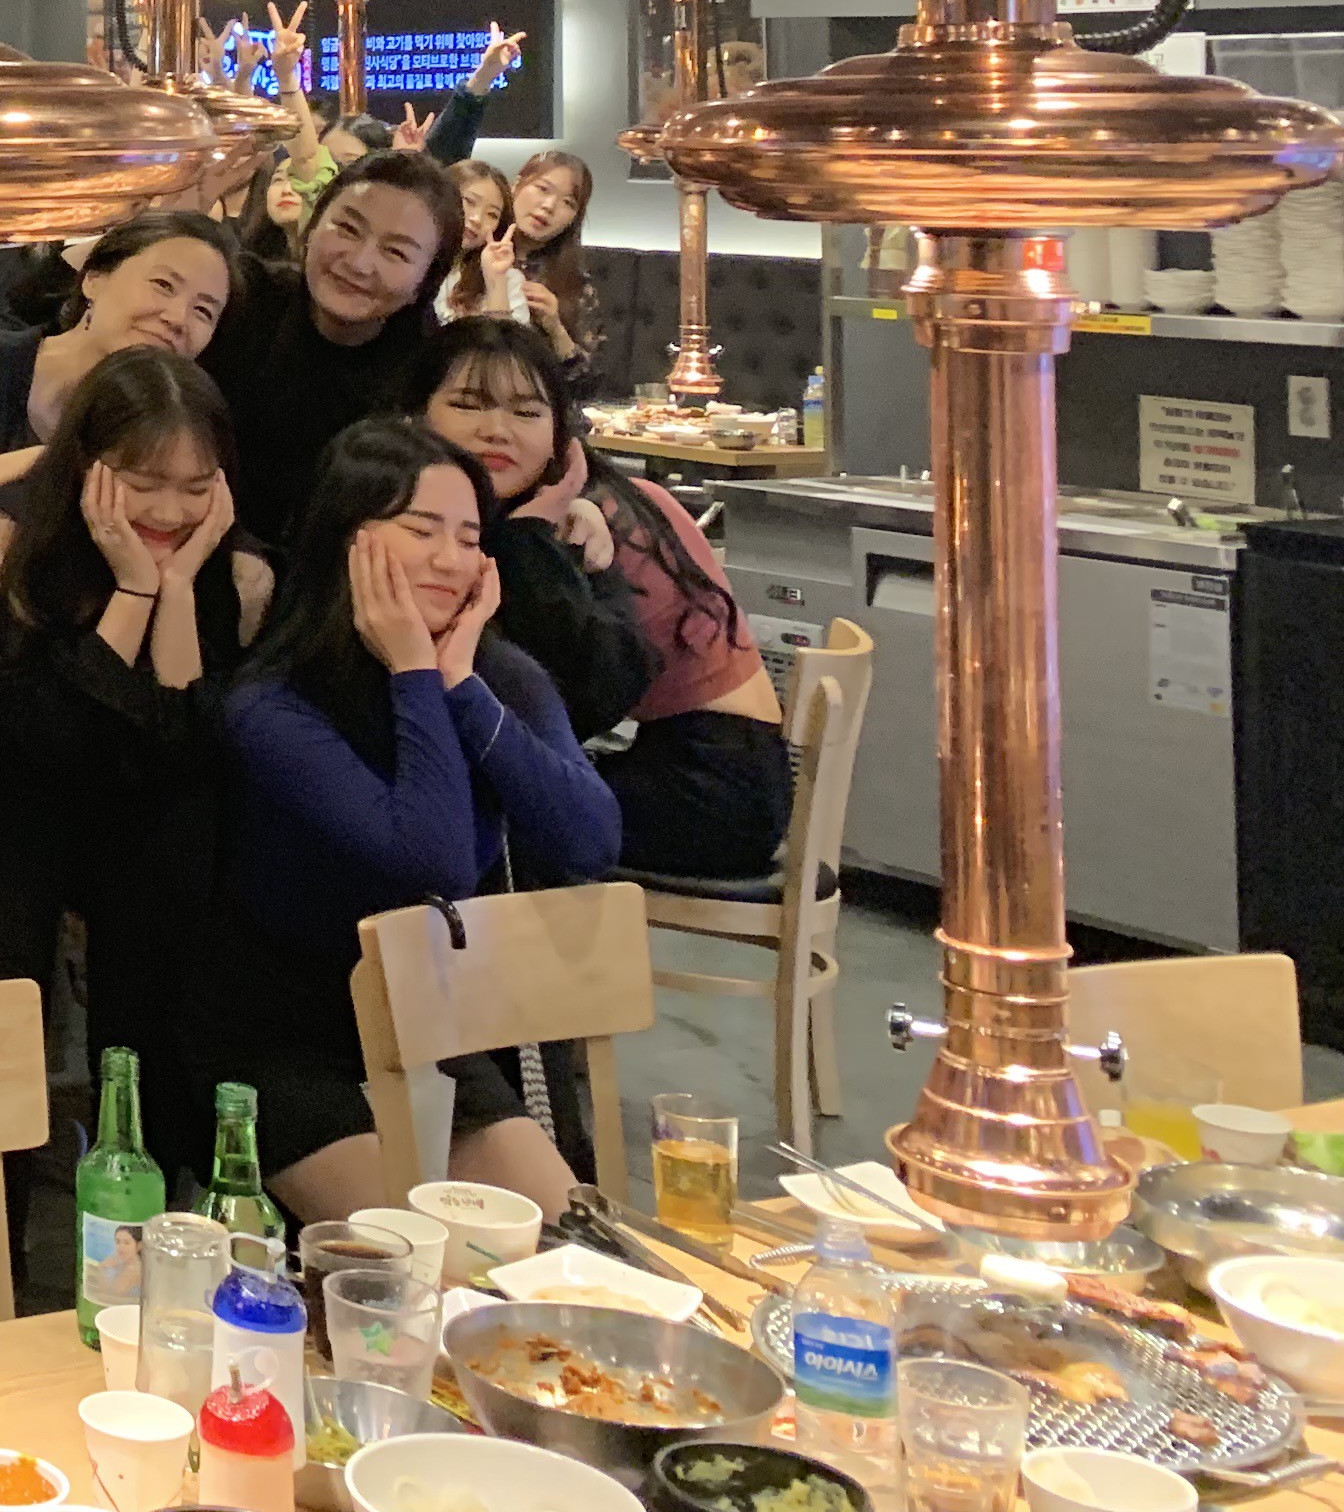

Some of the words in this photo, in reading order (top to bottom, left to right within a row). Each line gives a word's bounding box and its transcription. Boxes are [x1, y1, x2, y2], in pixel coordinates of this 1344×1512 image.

[320, 37, 340, 54] 임금
[365, 34, 386, 52] 비와
[385, 33, 414, 52] 고기를
[414, 33, 434, 51] 먹기
[434, 32, 455, 50] 위해
[320, 56, 340, 73] 명륜
[320, 74, 340, 91] 저렴
[364, 73, 377, 91] 과
